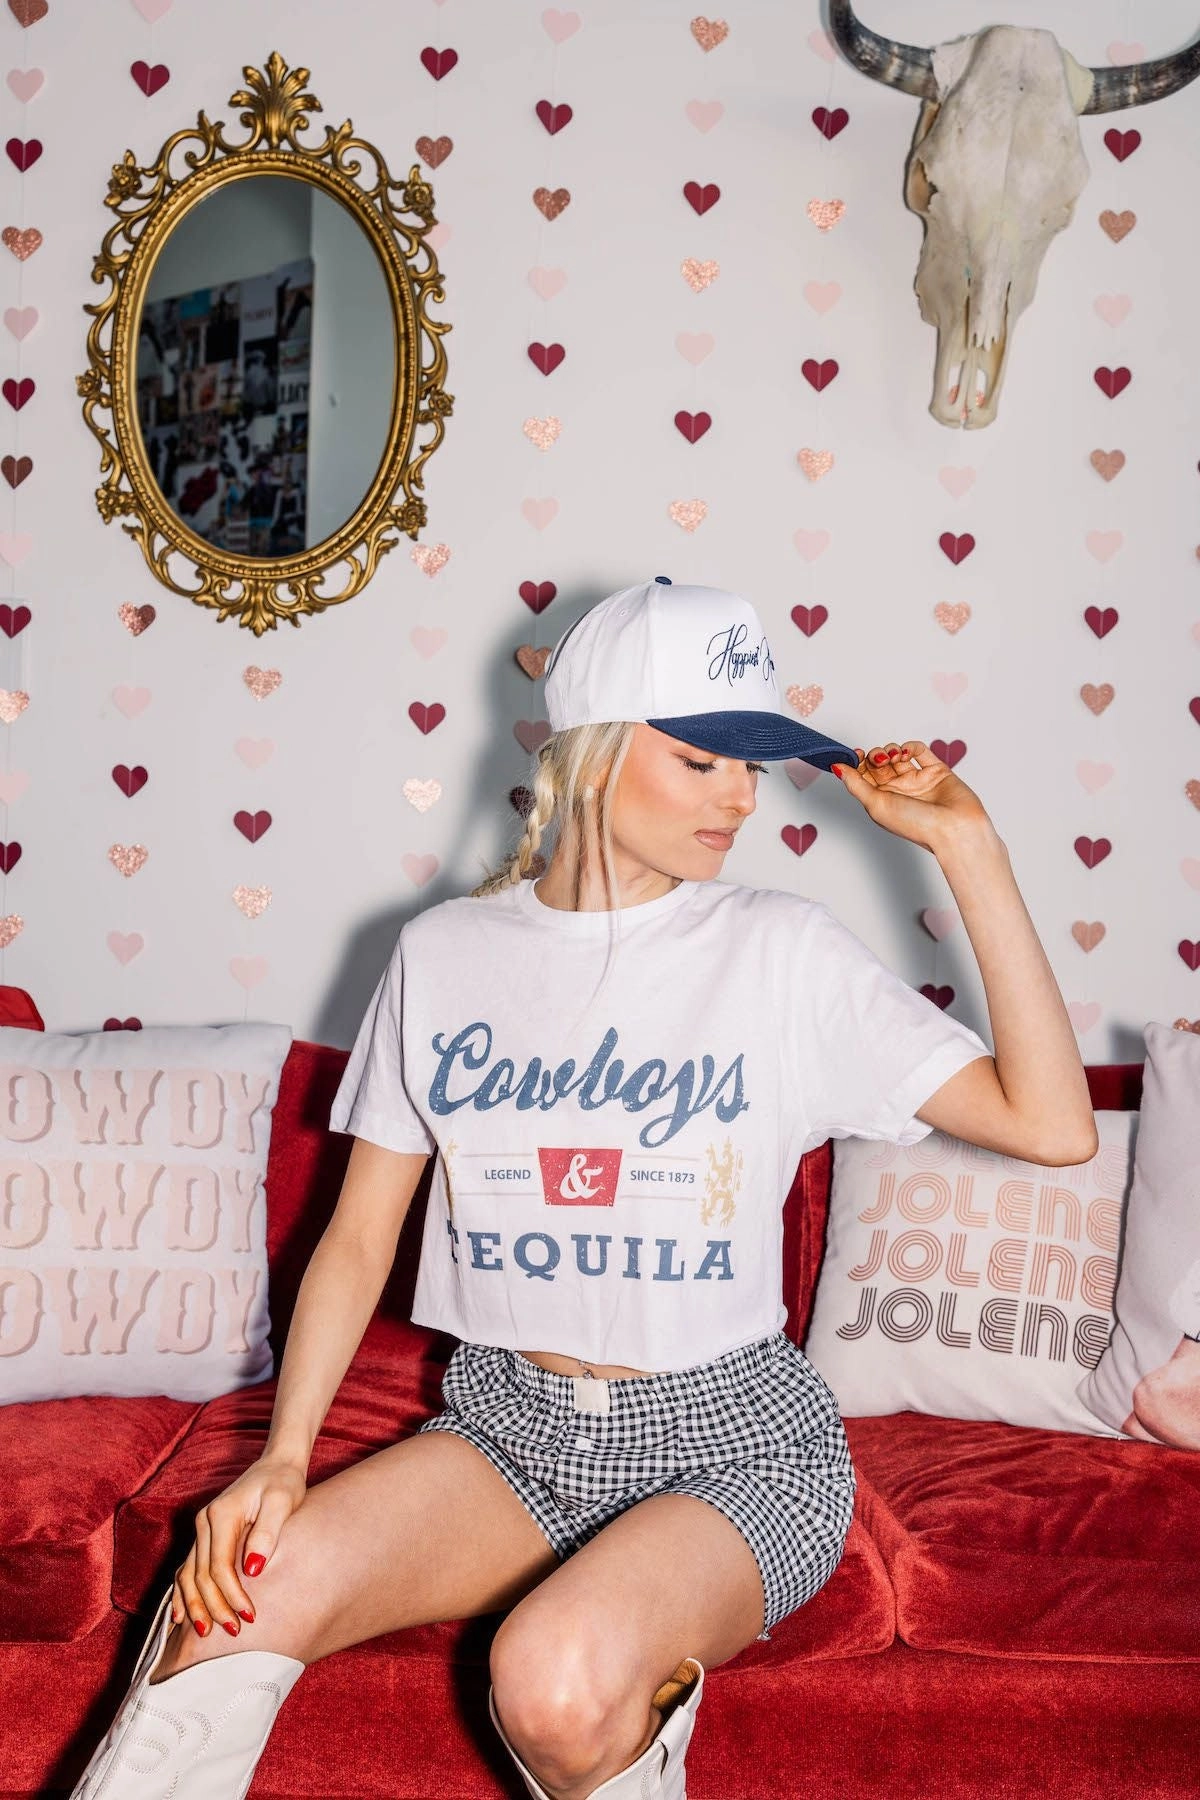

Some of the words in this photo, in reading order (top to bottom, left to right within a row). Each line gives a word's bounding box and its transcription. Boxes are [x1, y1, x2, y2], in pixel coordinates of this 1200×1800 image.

[428, 1021, 750, 1149] Cowboys
[484, 1168, 532, 1181] LEGEND
[559, 1153, 605, 1200] &
[629, 1169, 665, 1183] SINCE
[668, 1171, 696, 1185] 1873
